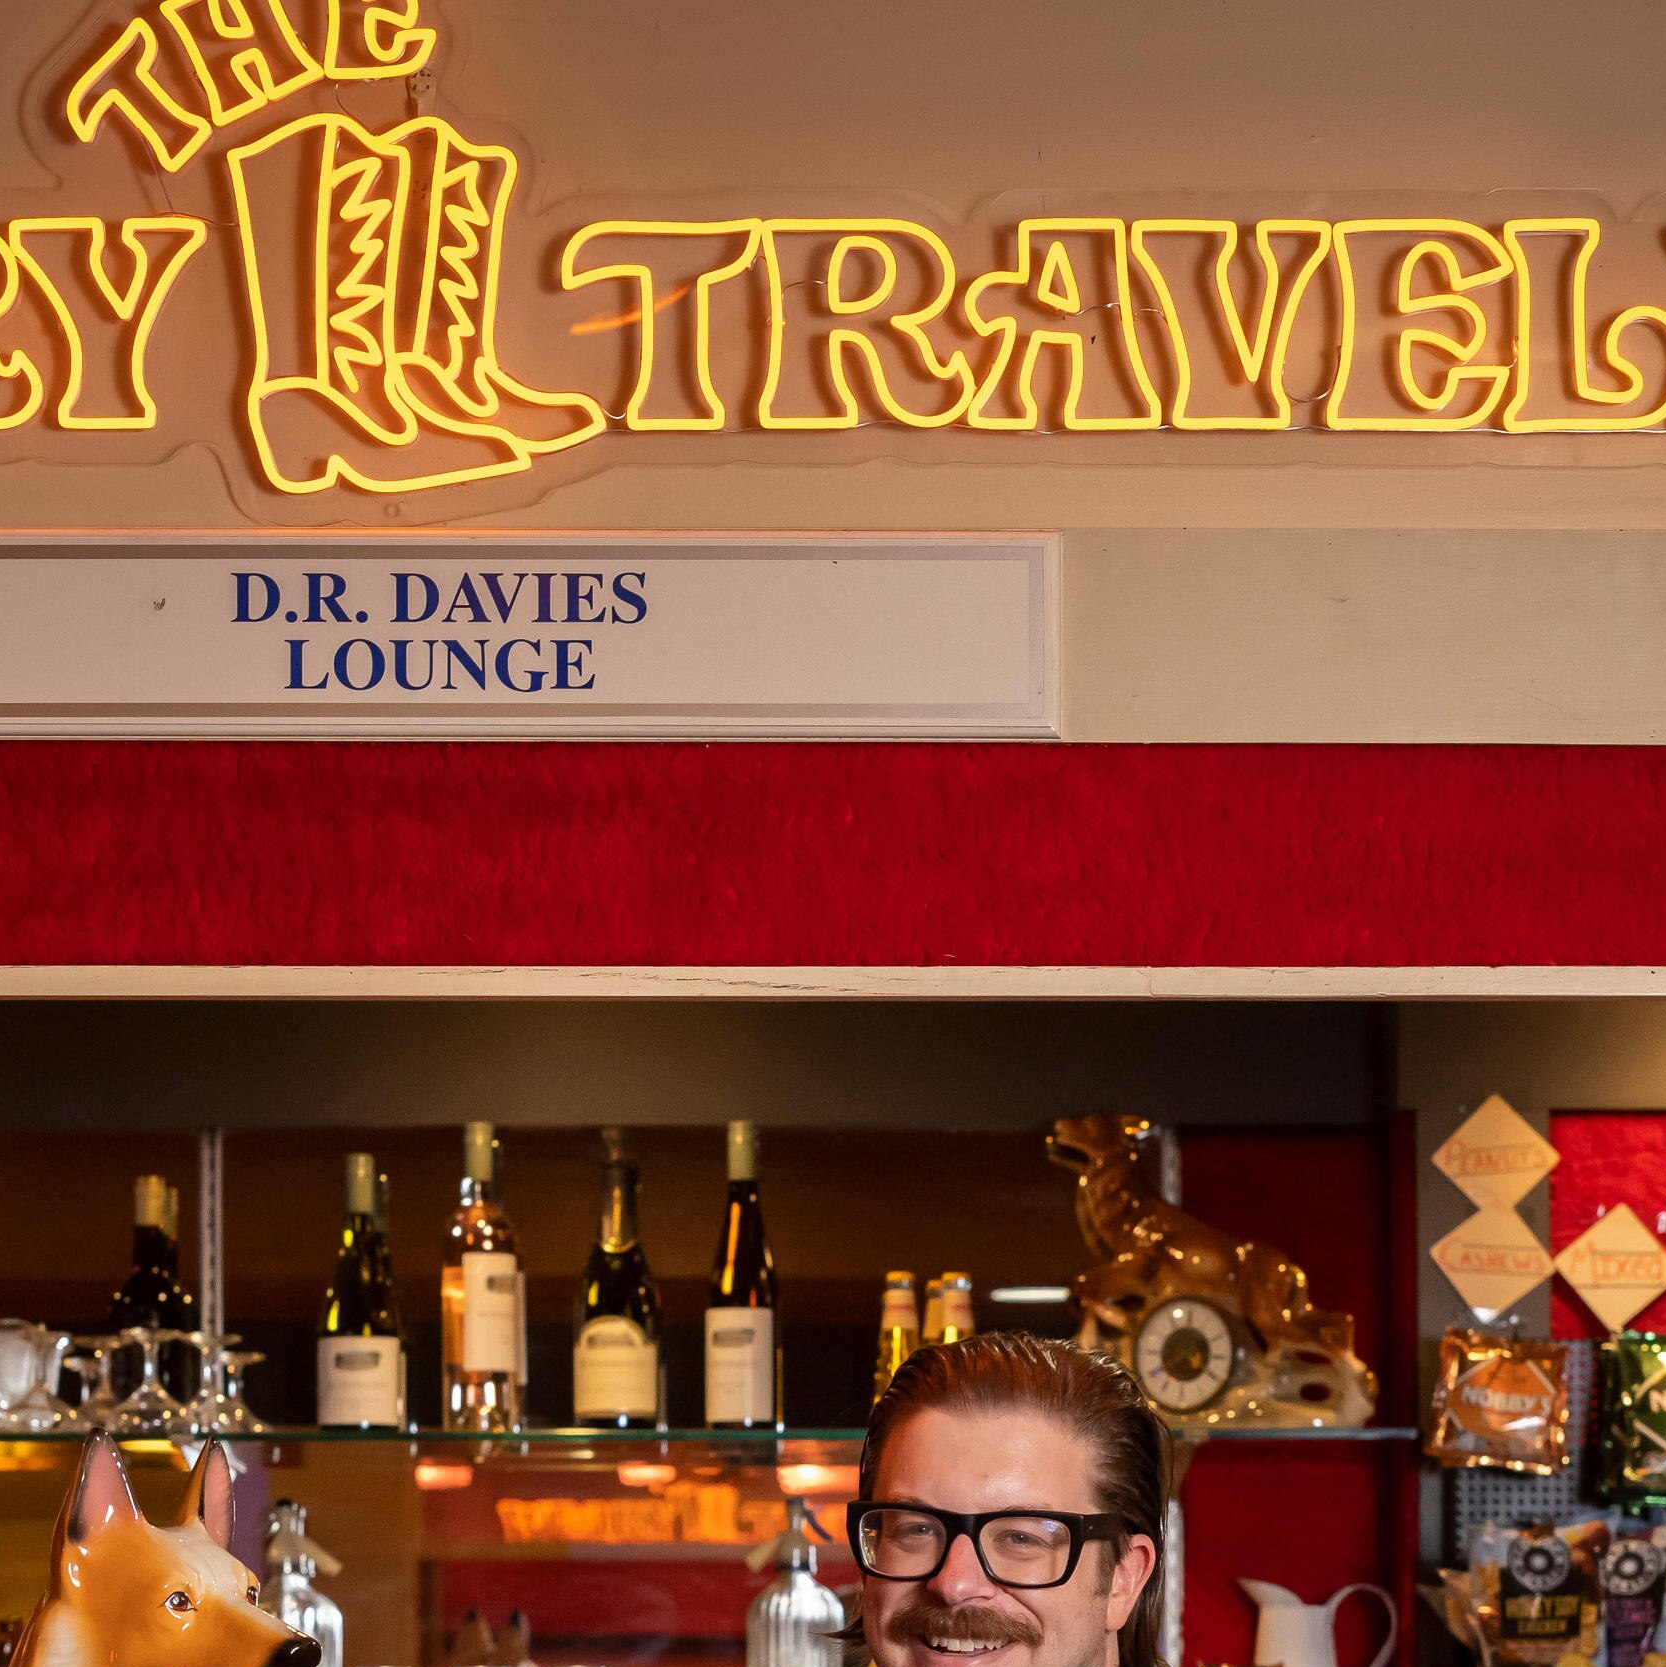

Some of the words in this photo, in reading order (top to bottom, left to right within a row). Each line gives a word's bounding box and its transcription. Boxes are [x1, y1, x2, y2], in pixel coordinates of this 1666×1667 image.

[67, 0, 437, 173] THE
[230, 571, 369, 624] D.R.
[389, 571, 648, 624] DAVIES
[283, 638, 597, 692] LOUNGE
[1463, 1386, 1550, 1414] NOBBY'S
